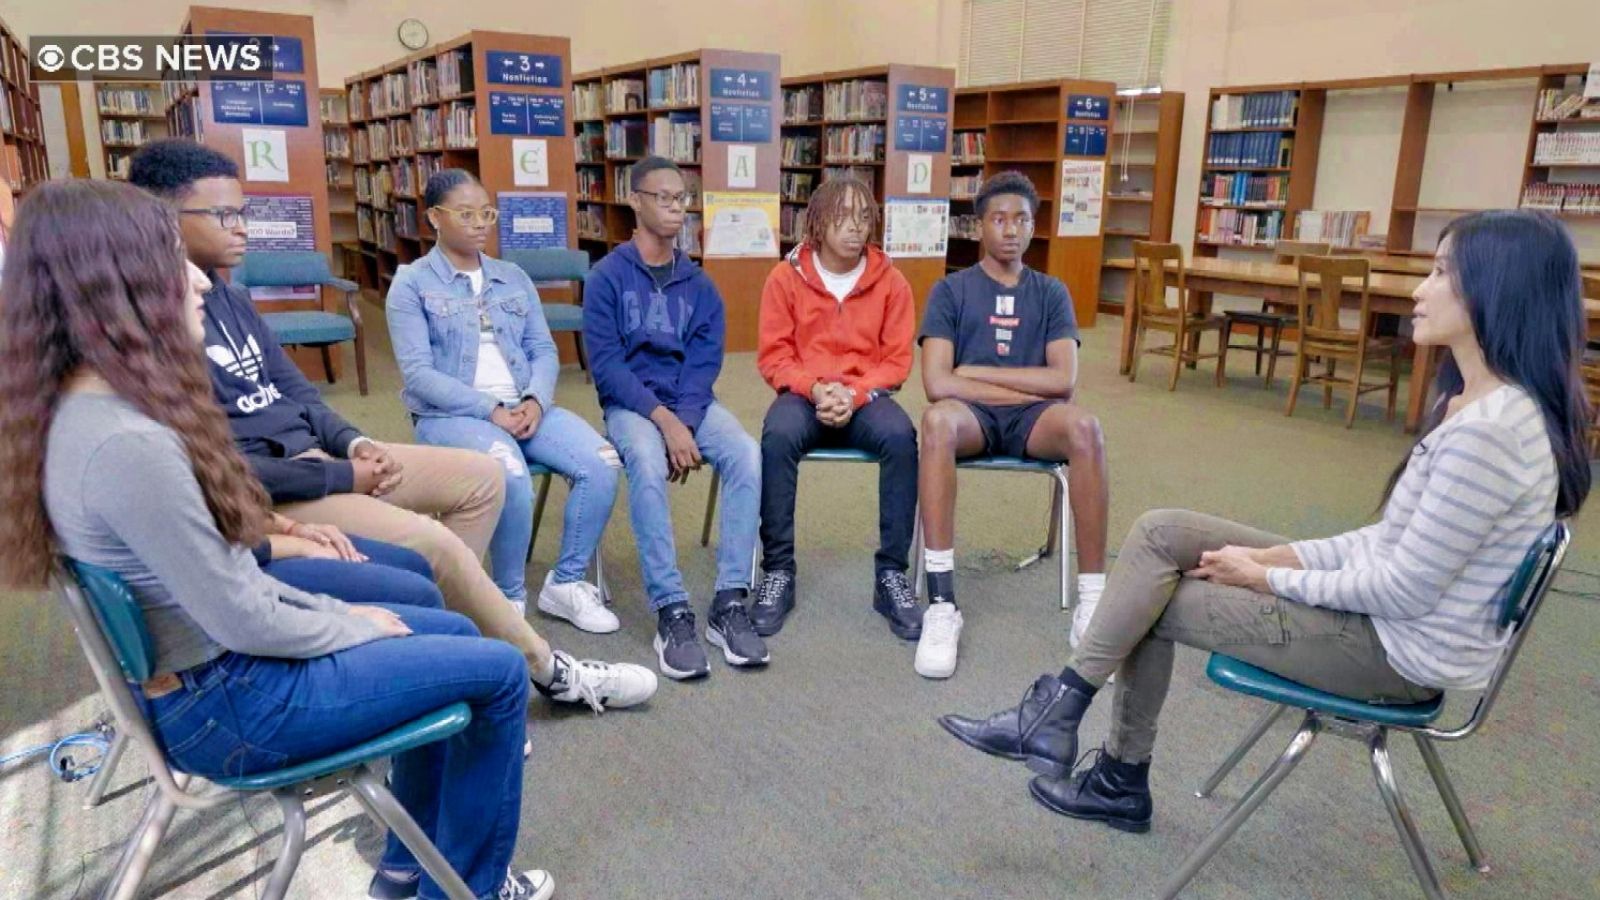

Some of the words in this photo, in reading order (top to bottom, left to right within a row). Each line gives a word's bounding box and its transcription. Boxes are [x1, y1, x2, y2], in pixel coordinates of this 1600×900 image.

[520, 55, 530, 71] 3
[503, 73, 548, 84] Nonfiction
[737, 73, 746, 87] 4
[919, 87, 927, 101] 5
[1086, 98, 1092, 110] 6
[246, 140, 285, 172] R
[520, 147, 541, 175] E
[733, 154, 749, 178] A
[911, 161, 929, 185] D
